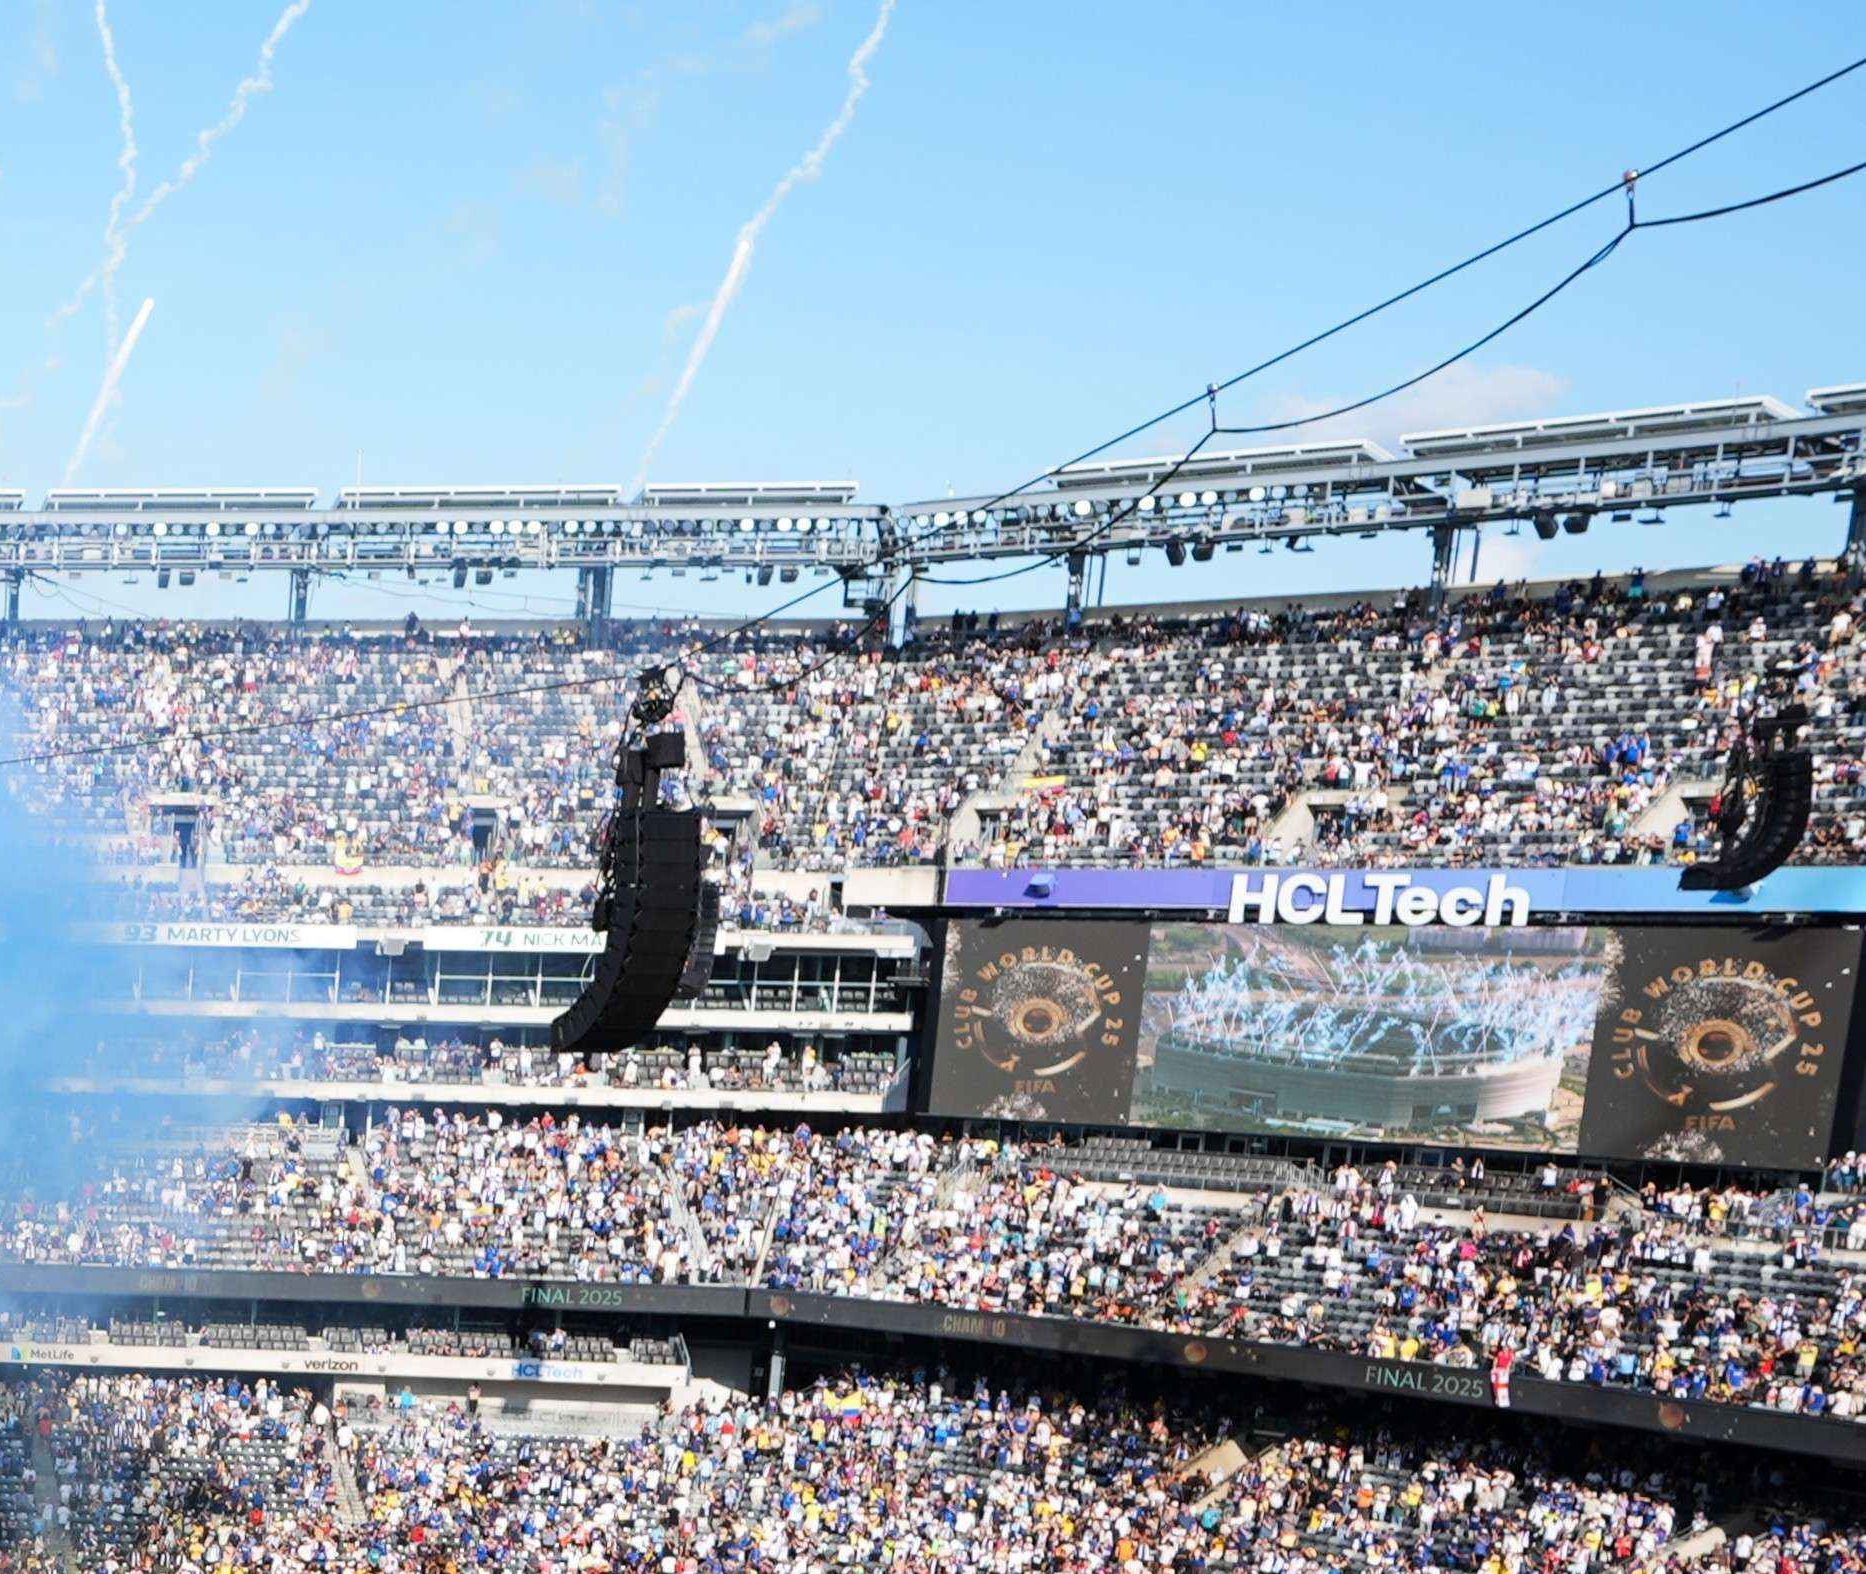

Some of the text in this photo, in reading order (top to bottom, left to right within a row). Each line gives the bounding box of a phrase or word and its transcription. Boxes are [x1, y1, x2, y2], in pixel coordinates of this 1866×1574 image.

[1229, 874, 1530, 926] HCLTech
[167, 926, 238, 942] MARTY
[242, 926, 301, 942] LYONS
[480, 931, 513, 947] 74
[521, 1287, 623, 1307] FINAL 2025
[30, 1348, 75, 1361] MetLife
[303, 1358, 359, 1372] verizon
[511, 1363, 584, 1379] HCLTech
[1365, 1364, 1485, 1400] FINAL 2025
